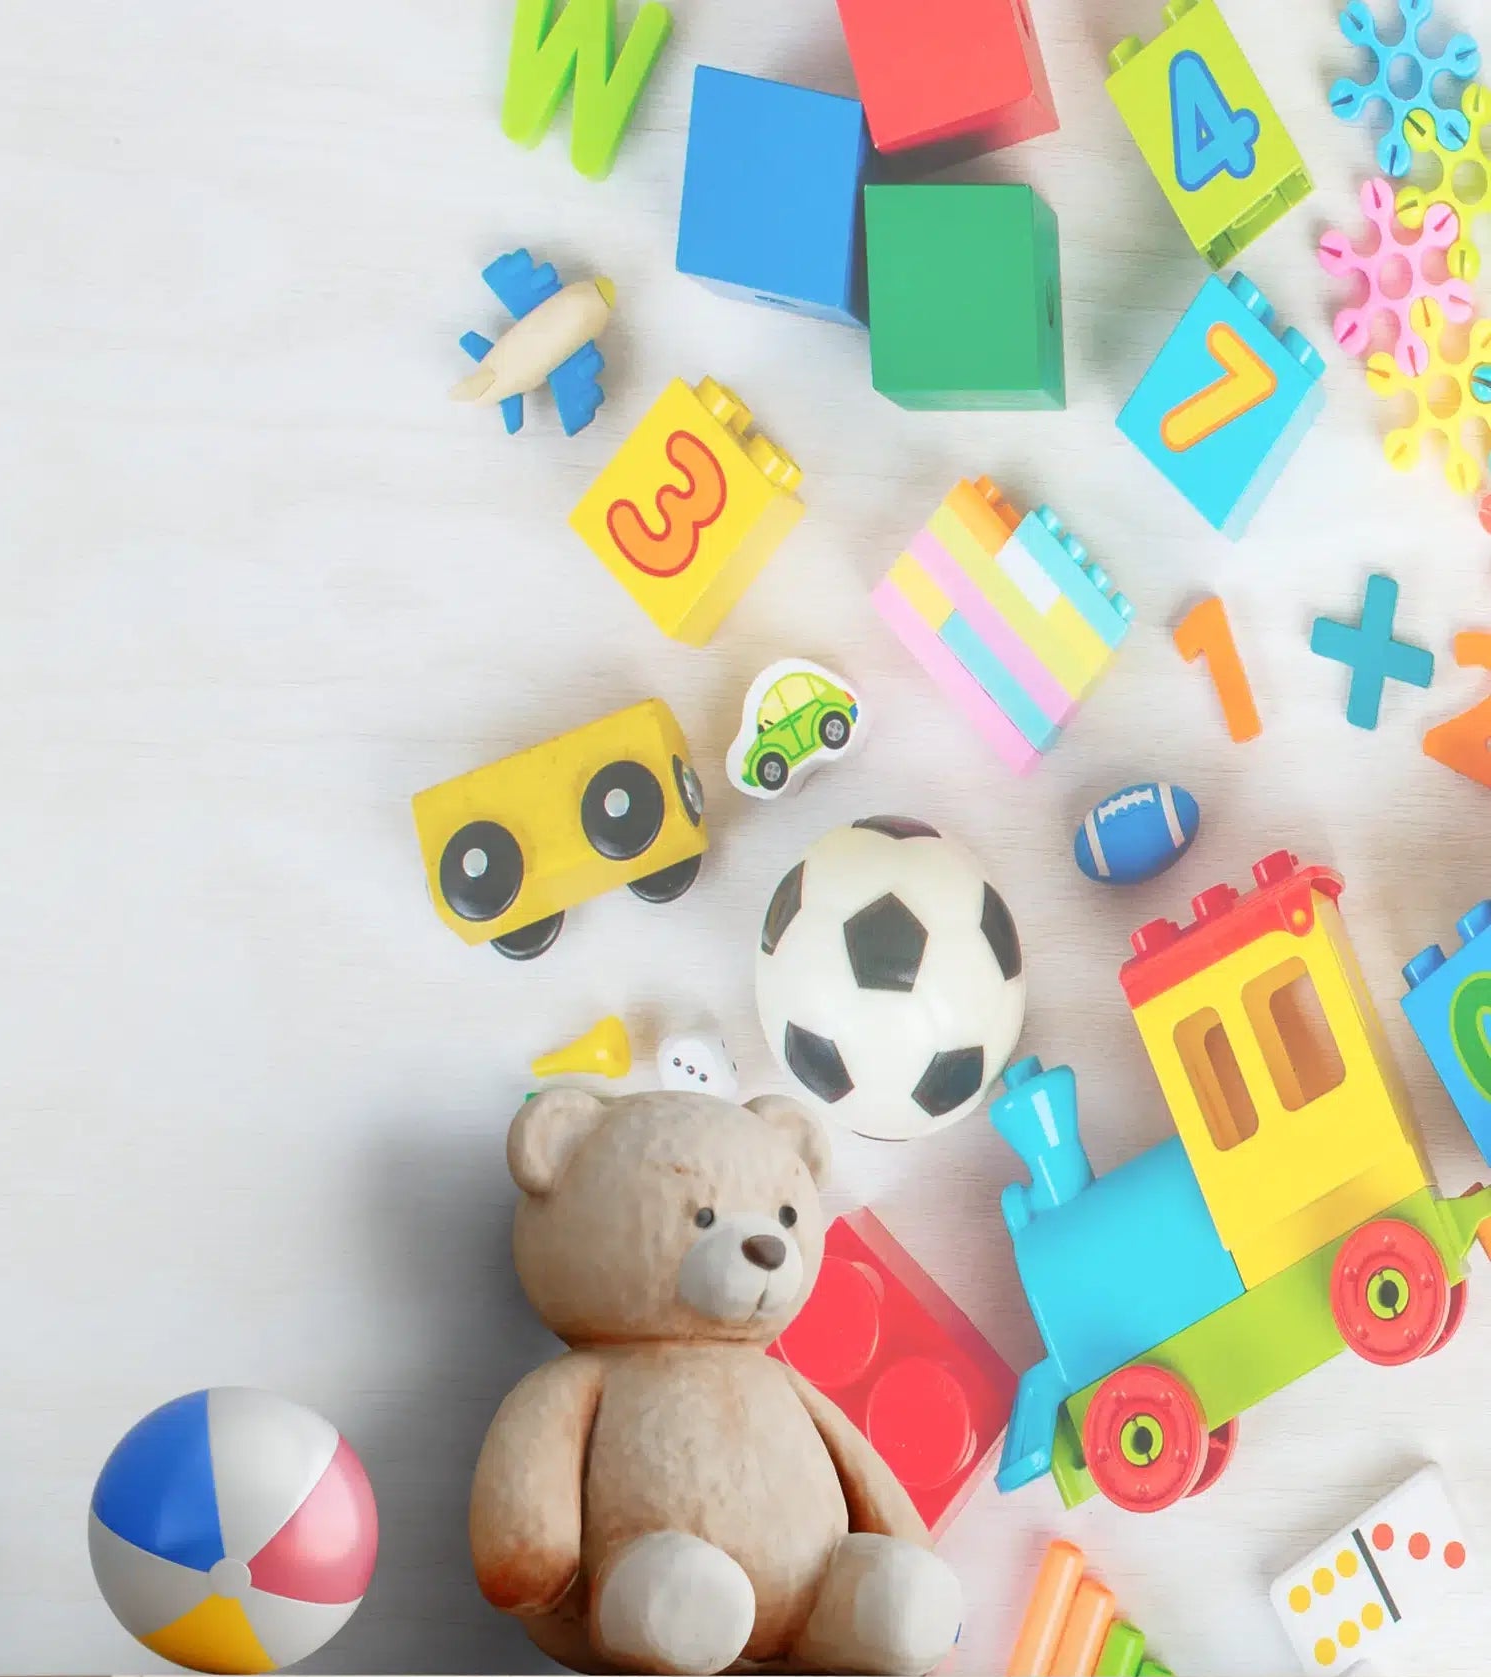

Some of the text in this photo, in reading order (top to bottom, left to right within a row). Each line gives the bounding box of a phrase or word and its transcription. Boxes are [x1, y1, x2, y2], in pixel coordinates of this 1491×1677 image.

[1168, 49, 1260, 192] 4
[1160, 321, 1279, 454] 7
[606, 429, 728, 578] 3
[1173, 596, 1263, 744] 1
